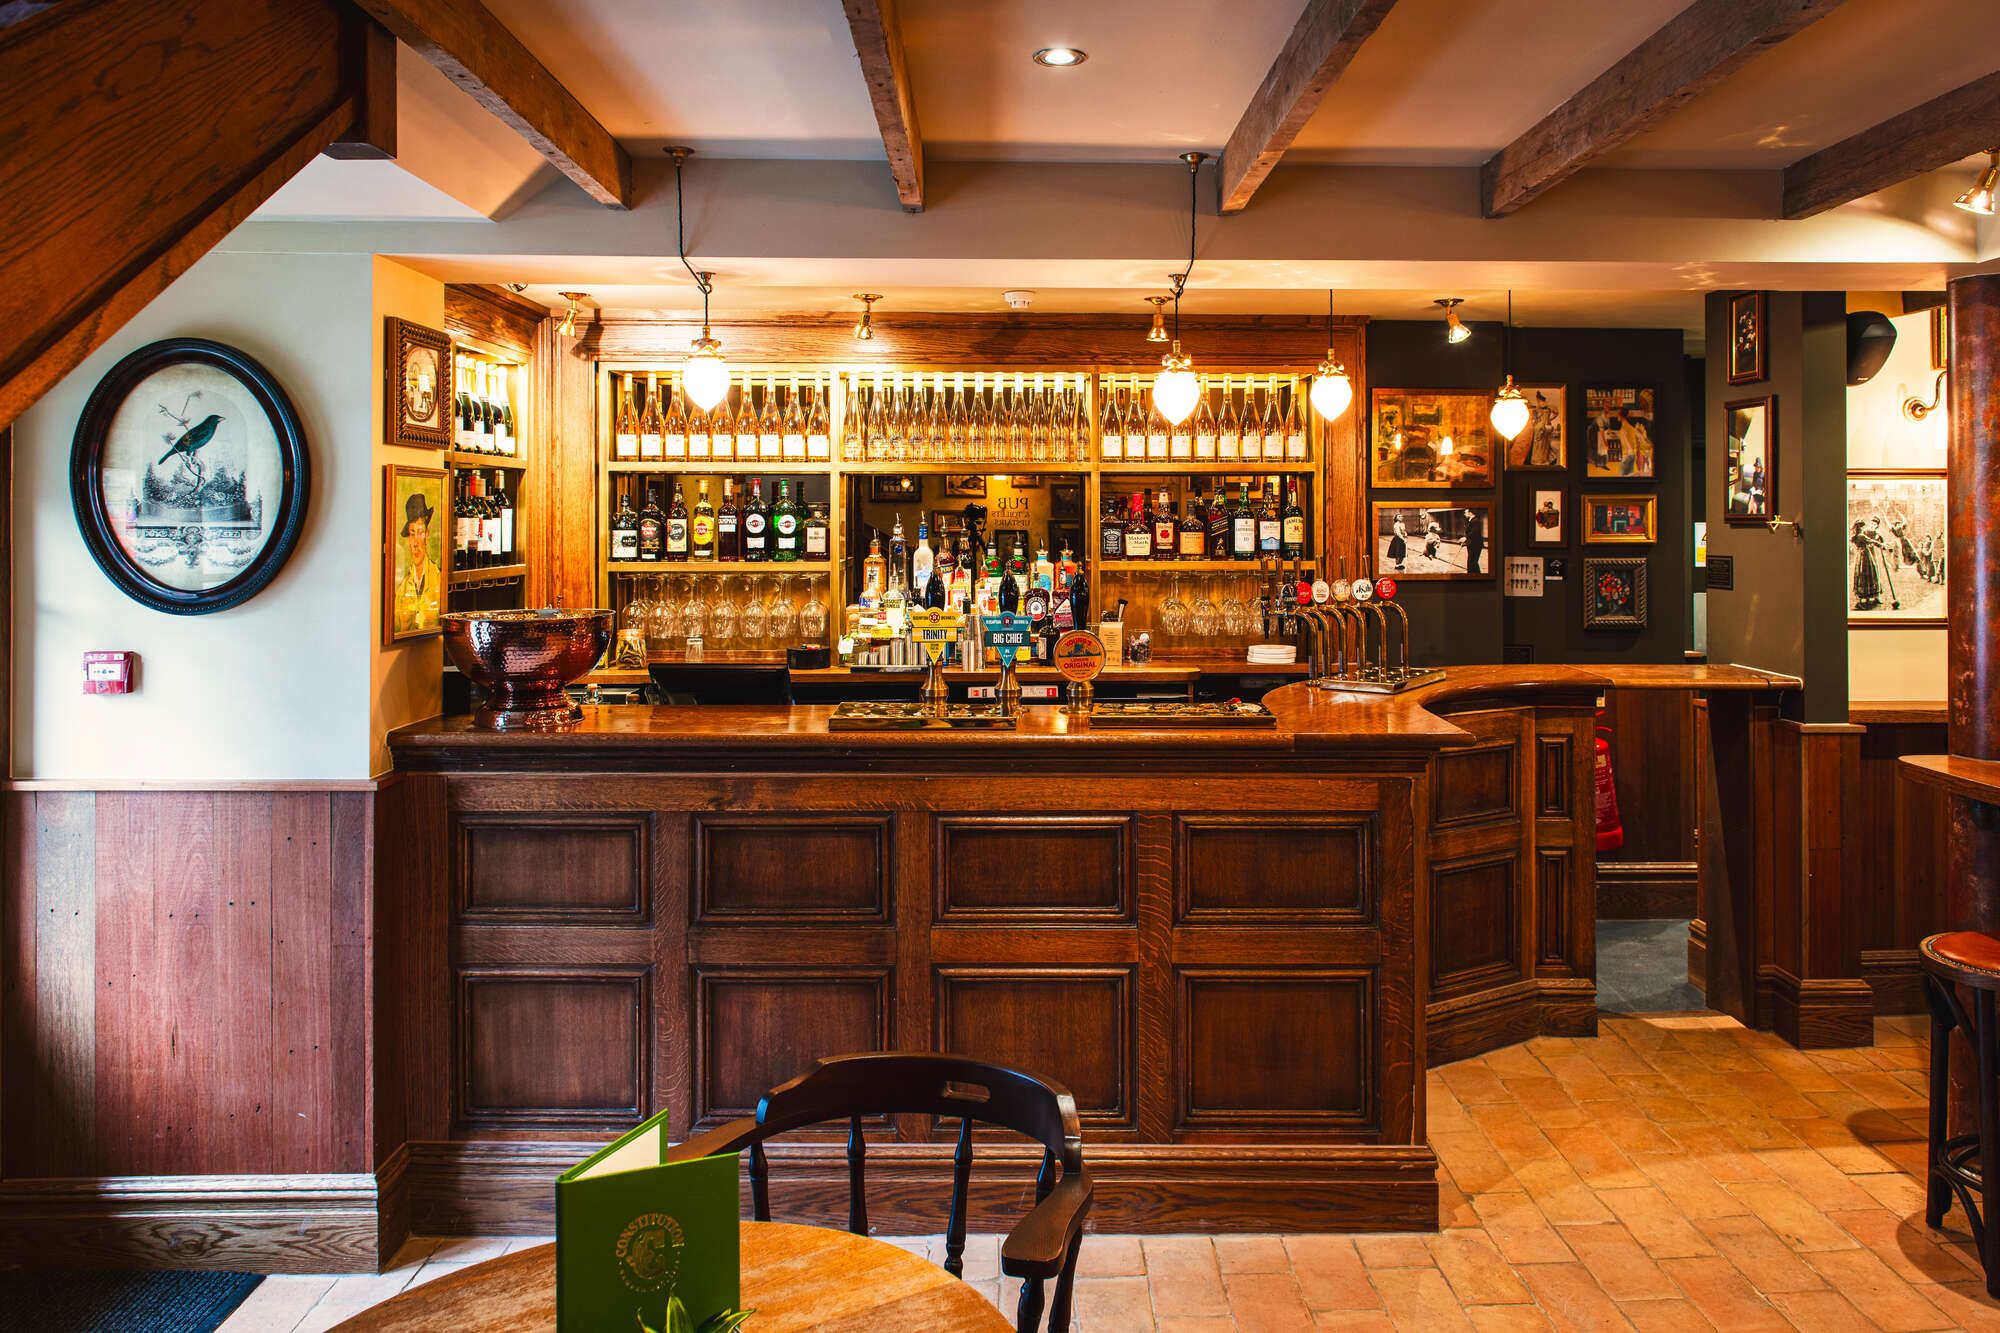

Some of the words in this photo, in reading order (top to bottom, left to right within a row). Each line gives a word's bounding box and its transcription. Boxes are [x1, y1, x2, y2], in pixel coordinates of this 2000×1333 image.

[922, 629, 947, 640] TRINITY
[993, 633, 1005, 644] BIG
[1006, 633, 1023, 644] CHIEF
